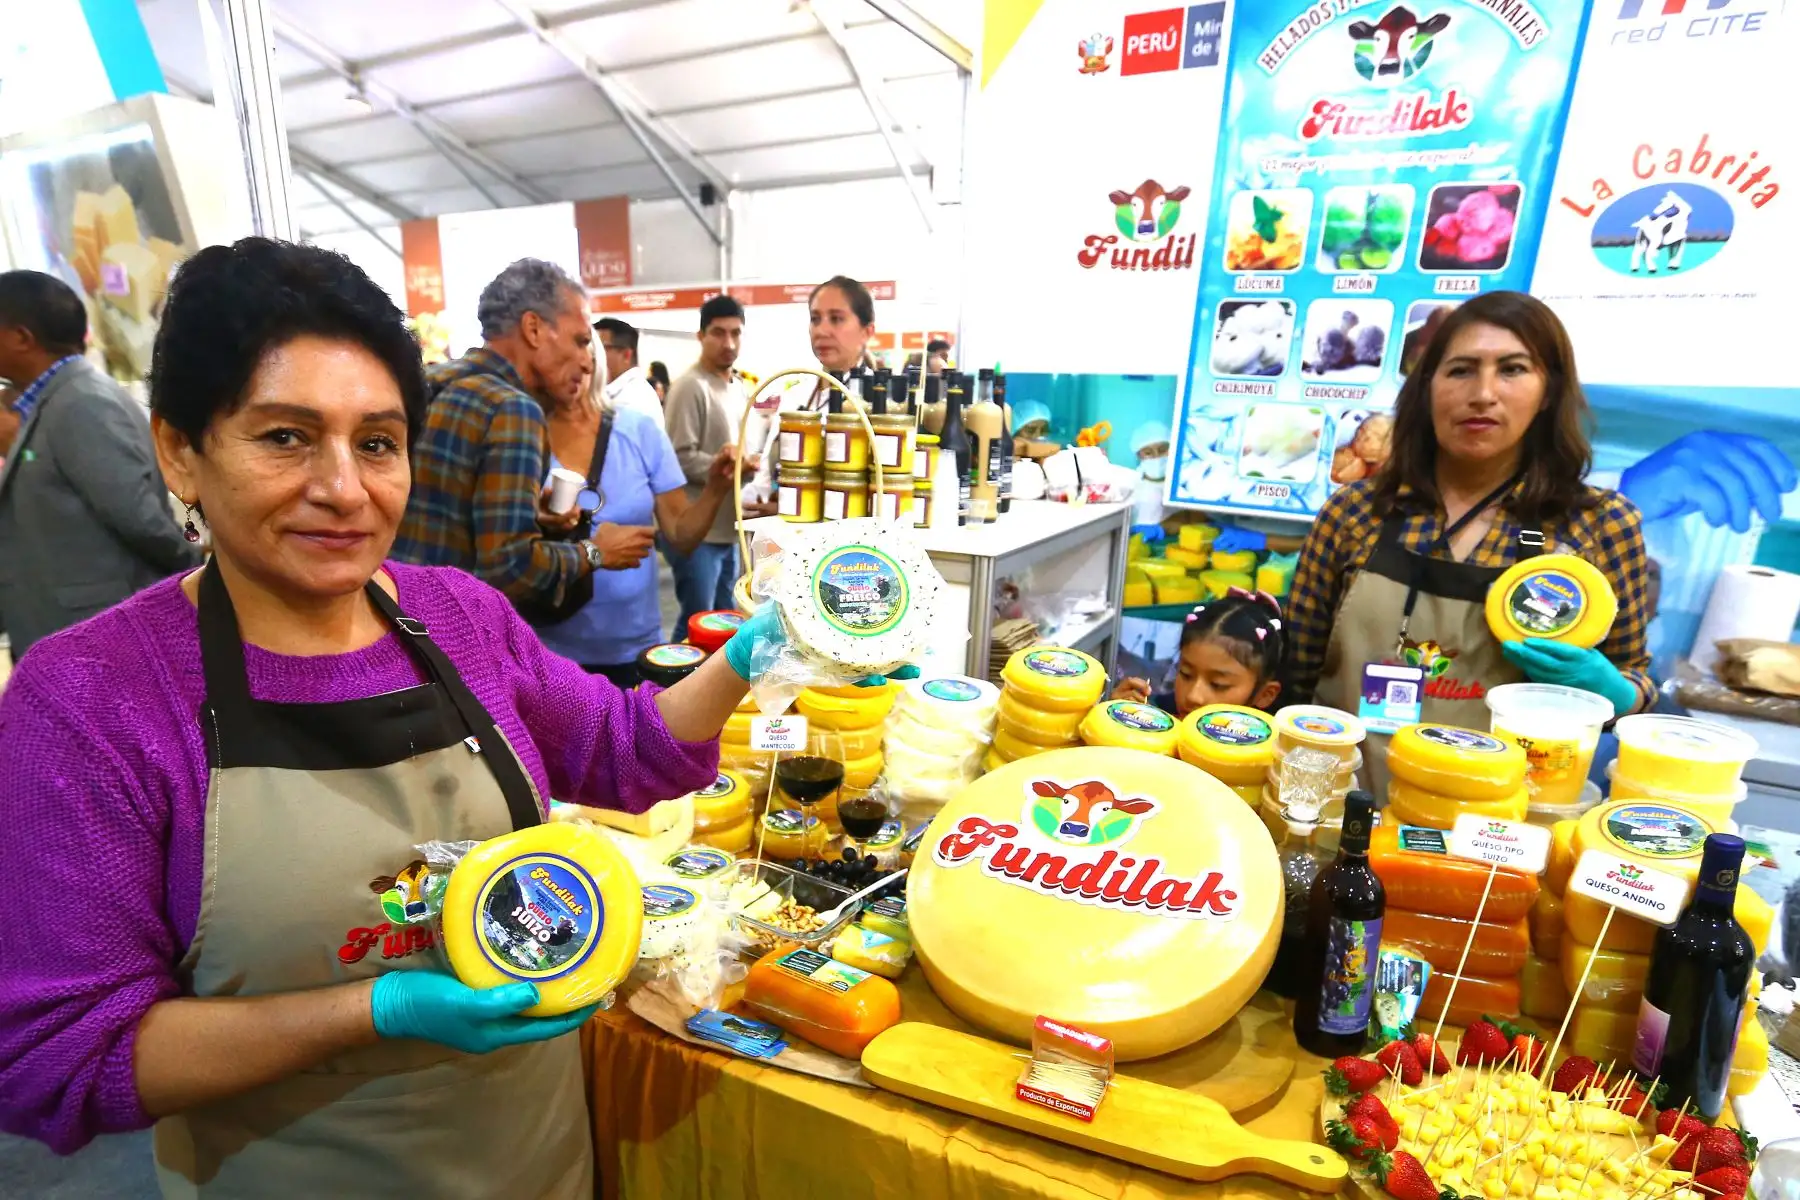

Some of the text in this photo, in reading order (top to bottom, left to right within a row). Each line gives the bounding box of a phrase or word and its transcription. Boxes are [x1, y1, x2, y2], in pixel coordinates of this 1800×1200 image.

[1126, 25, 1178, 56] PERÚ
[1261, 1, 1331, 69] HELADOS
[1611, 11, 1768, 45] red CITE
[1191, 39, 1213, 57] de
[1302, 90, 1468, 138] Fundilak
[1560, 133, 1780, 218] La Cabrita
[1257, 483, 1289, 497] PISCO
[1471, 839, 1525, 856] QUESO TIPO
[1482, 852, 1508, 863] SUIZO
[937, 817, 1238, 915] Fundilak
[1606, 870, 1656, 892] Fundilak
[530, 867, 584, 916] Fundilak
[1585, 878, 1666, 911] QUESO ANDINO
[511, 906, 551, 943] SUIZO
[528, 902, 552, 925] QUESO
[1019, 1088, 1091, 1118] Producto de Exportación
